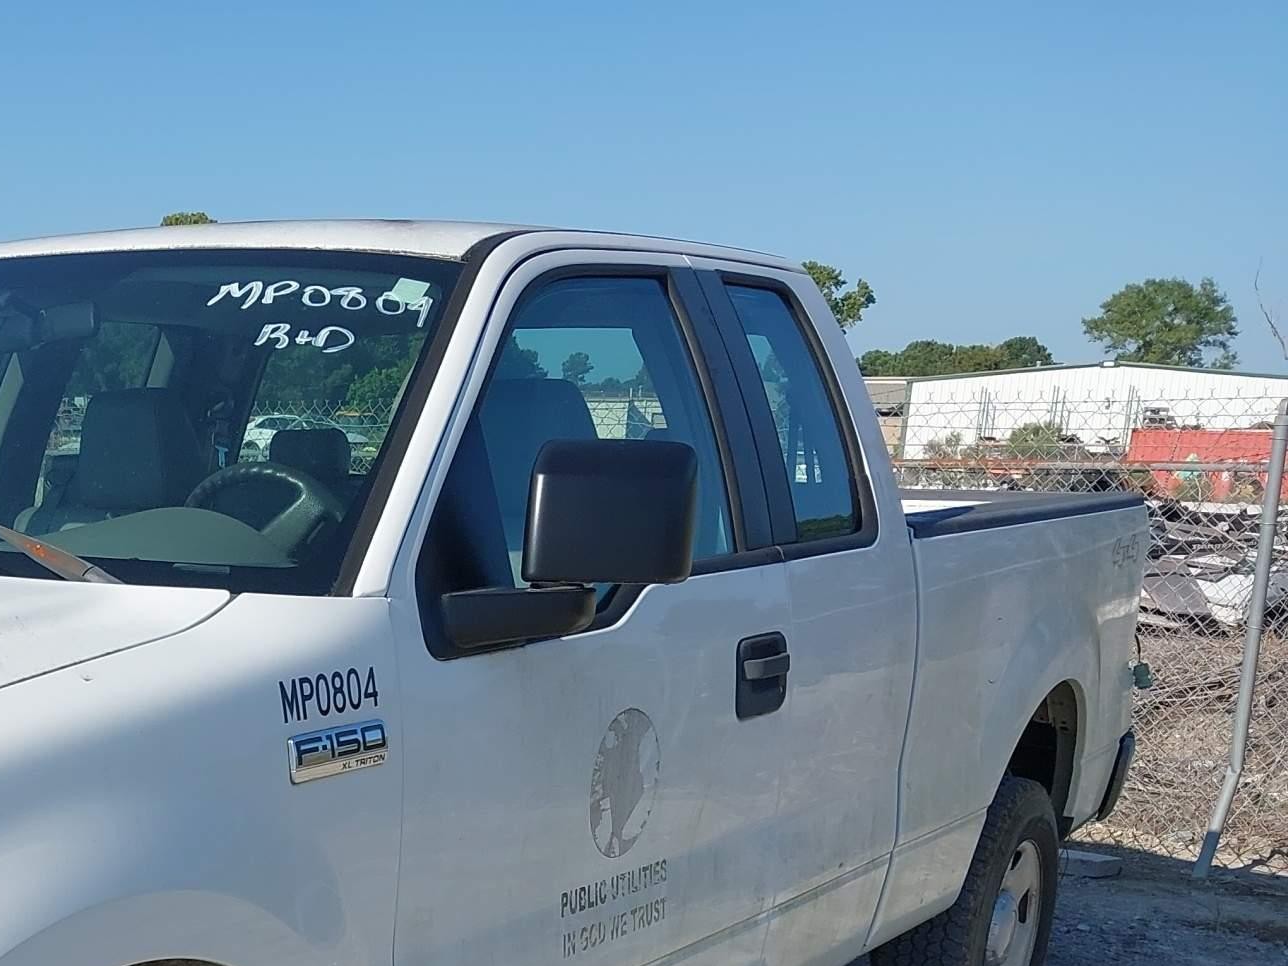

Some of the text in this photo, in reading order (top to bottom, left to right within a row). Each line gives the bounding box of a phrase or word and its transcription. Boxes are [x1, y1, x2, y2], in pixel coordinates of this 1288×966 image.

[278, 666, 379, 724] MP0804
[341, 754, 386, 770] XL TRITON
[561, 858, 667, 918] PUBLIC UTILITIES
[562, 930, 576, 959] IN
[610, 912, 628, 941] WE
[630, 897, 667, 932] TRUST
